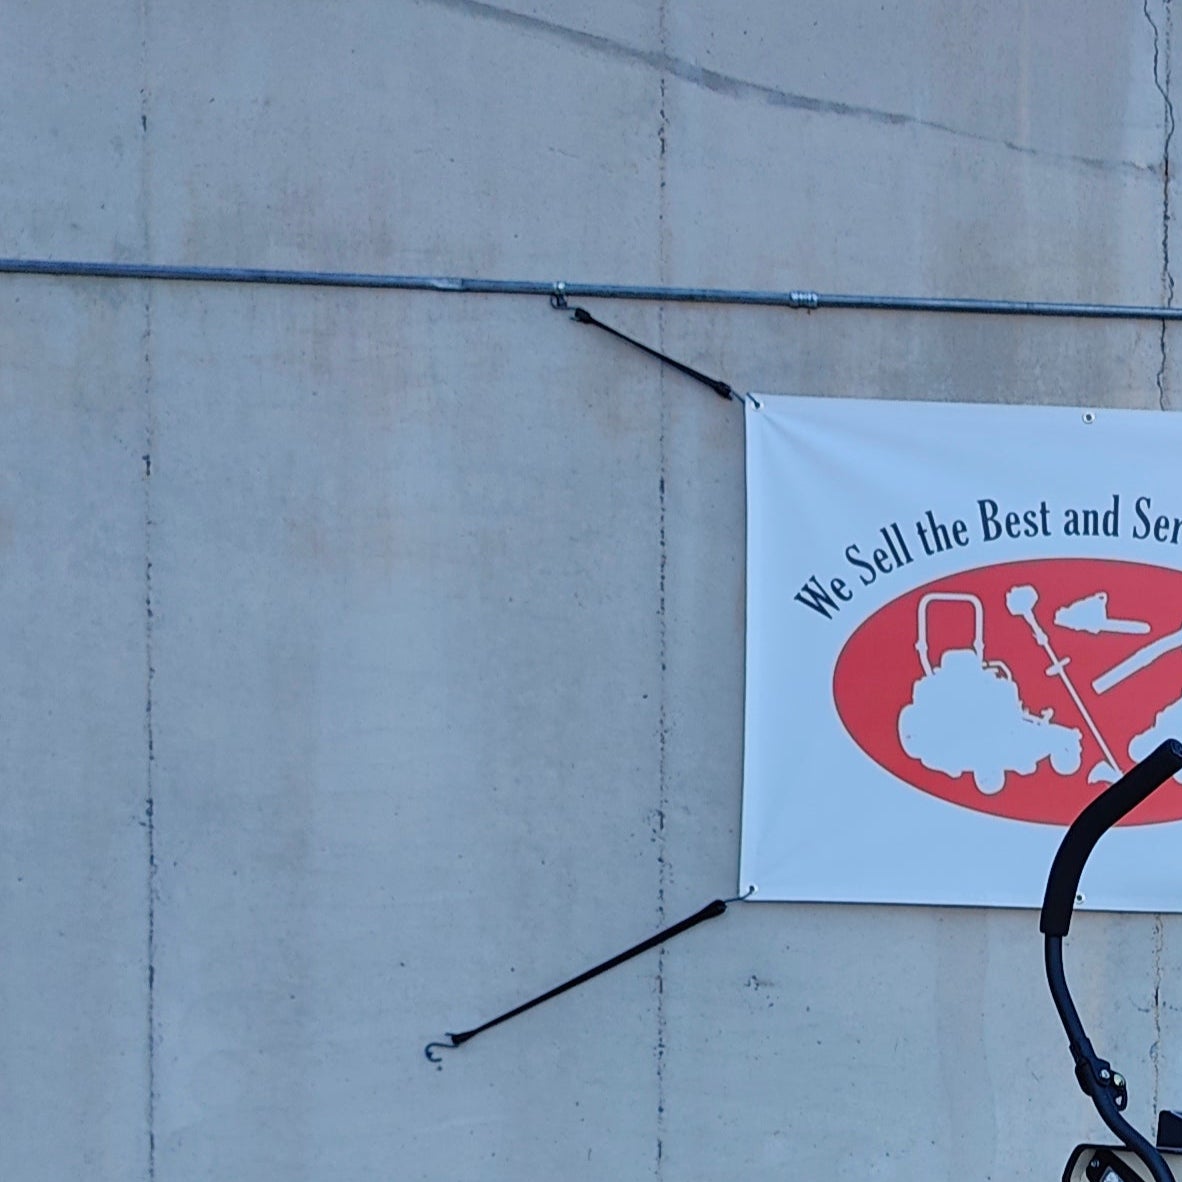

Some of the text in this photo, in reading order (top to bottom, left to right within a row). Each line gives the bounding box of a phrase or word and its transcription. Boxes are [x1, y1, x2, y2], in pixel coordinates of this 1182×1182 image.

[794, 575, 853, 620] We
[845, 522, 914, 586] Sell
[916, 510, 970, 556] the
[977, 498, 1052, 542] Best
[1063, 494, 1120, 537] and
